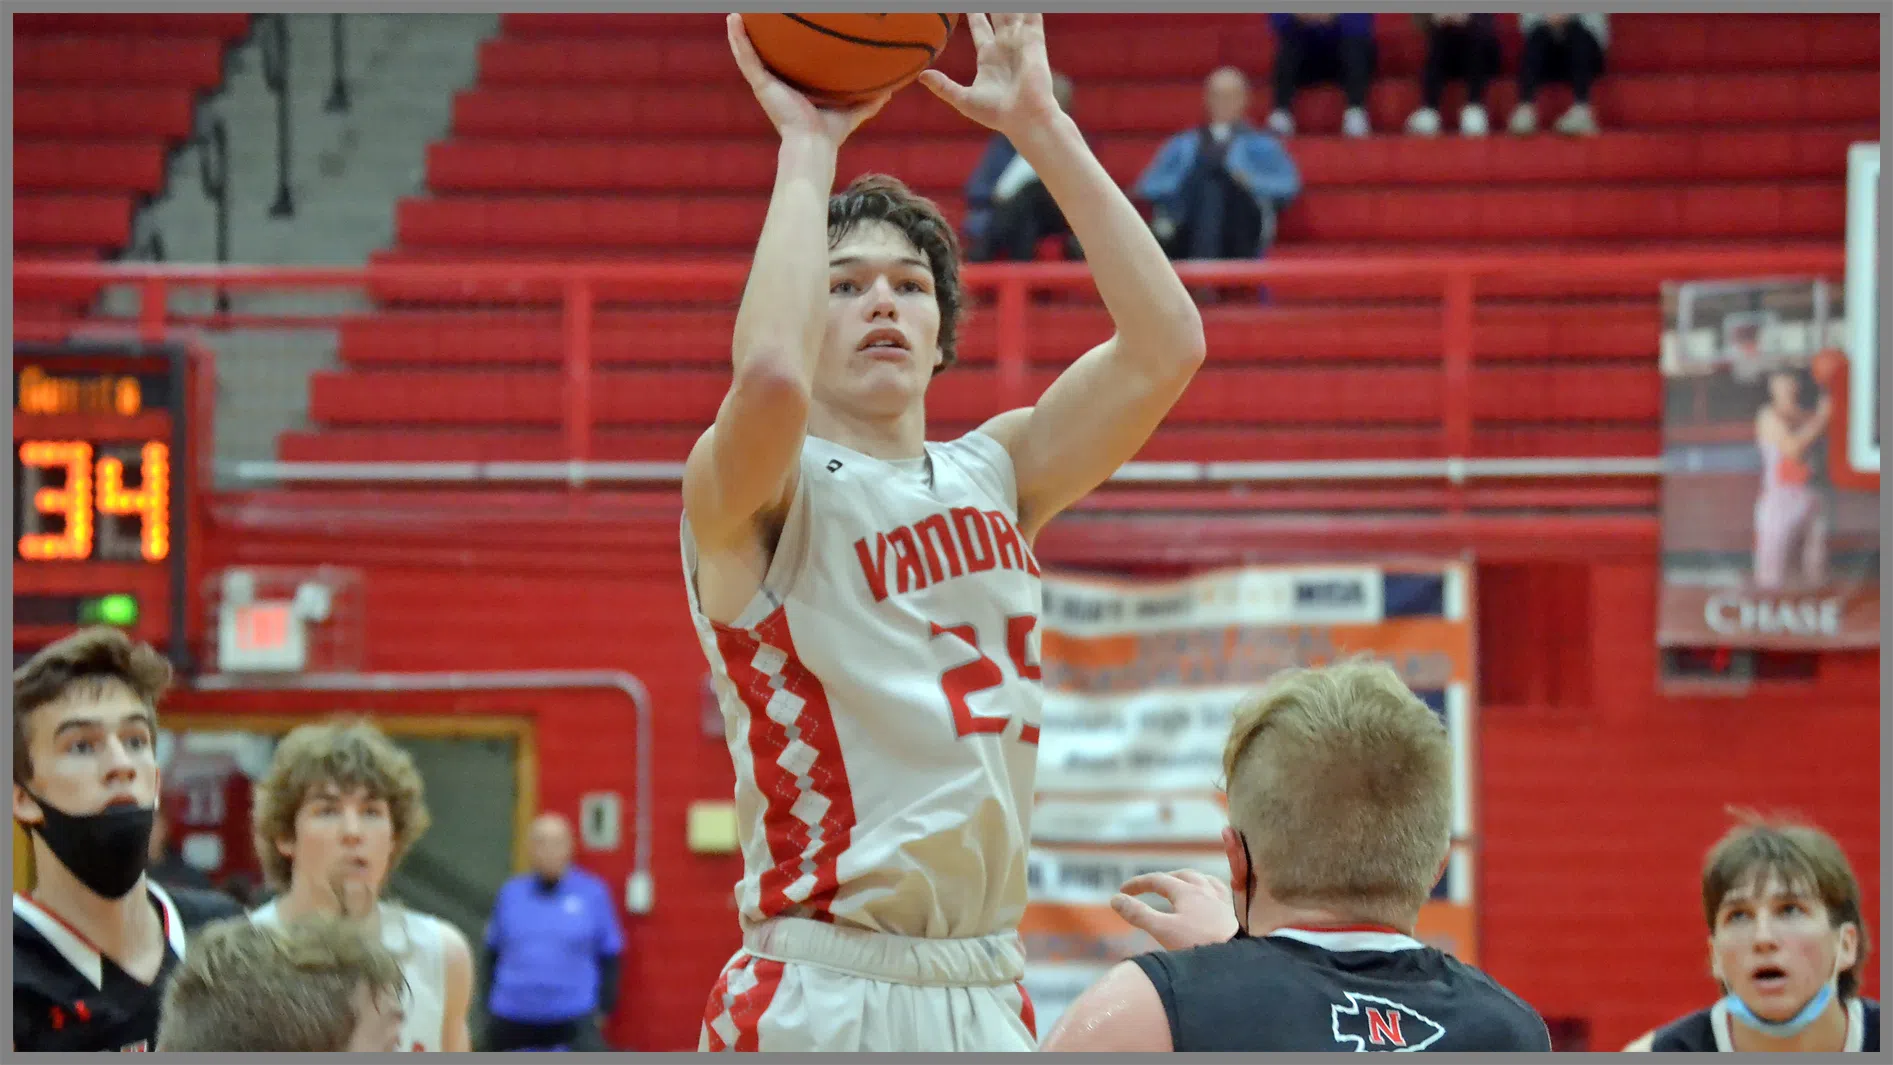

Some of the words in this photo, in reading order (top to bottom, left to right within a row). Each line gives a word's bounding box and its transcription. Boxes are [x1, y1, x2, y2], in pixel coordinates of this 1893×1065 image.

[18, 440, 171, 562] 34
[1704, 596, 1841, 637] CHASE
[929, 614, 1041, 746] 25
[1365, 1007, 1407, 1046] N
